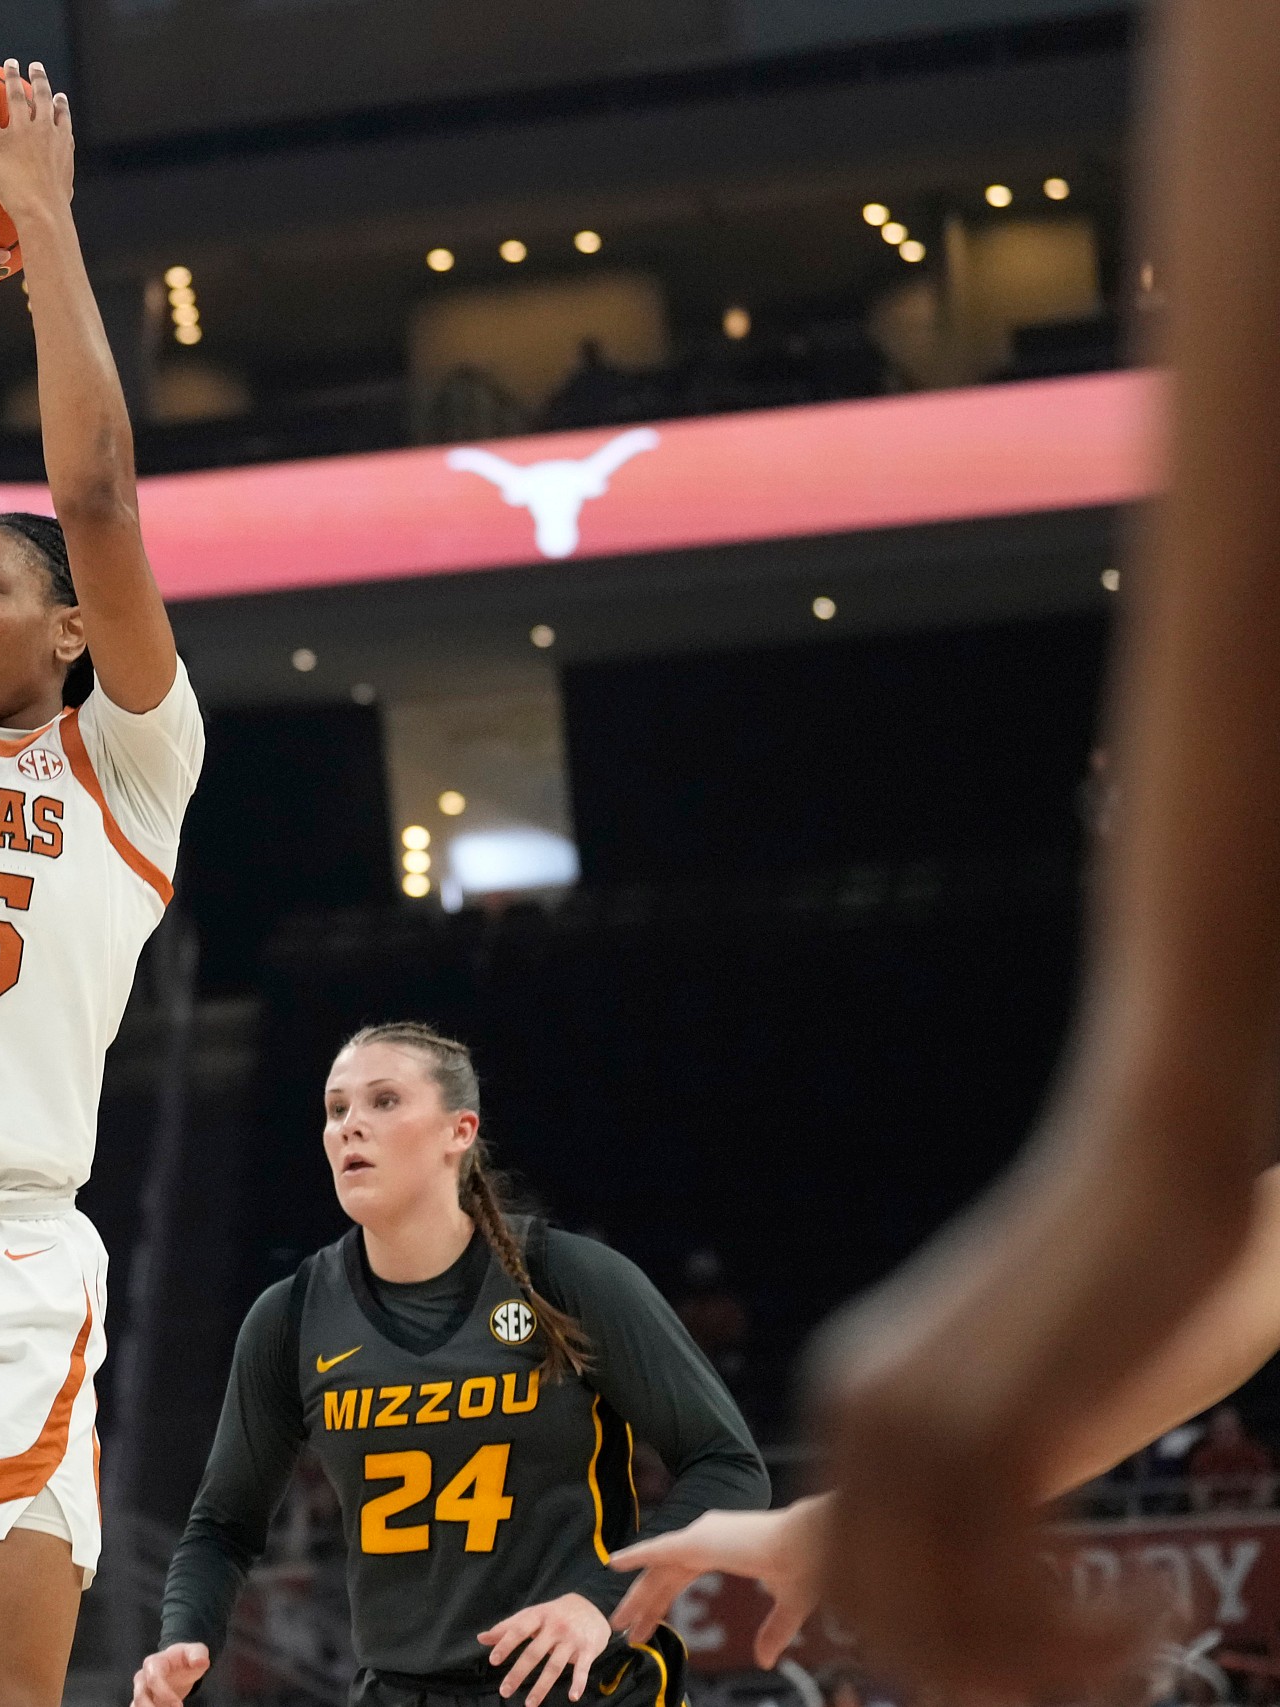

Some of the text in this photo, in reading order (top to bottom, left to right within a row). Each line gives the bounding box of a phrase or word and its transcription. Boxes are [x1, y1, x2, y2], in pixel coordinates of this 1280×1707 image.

[17, 749, 63, 780] SEC
[493, 1302, 533, 1342] SEC
[323, 1370, 541, 1430] MIZZOU
[361, 1443, 514, 1555] 24
